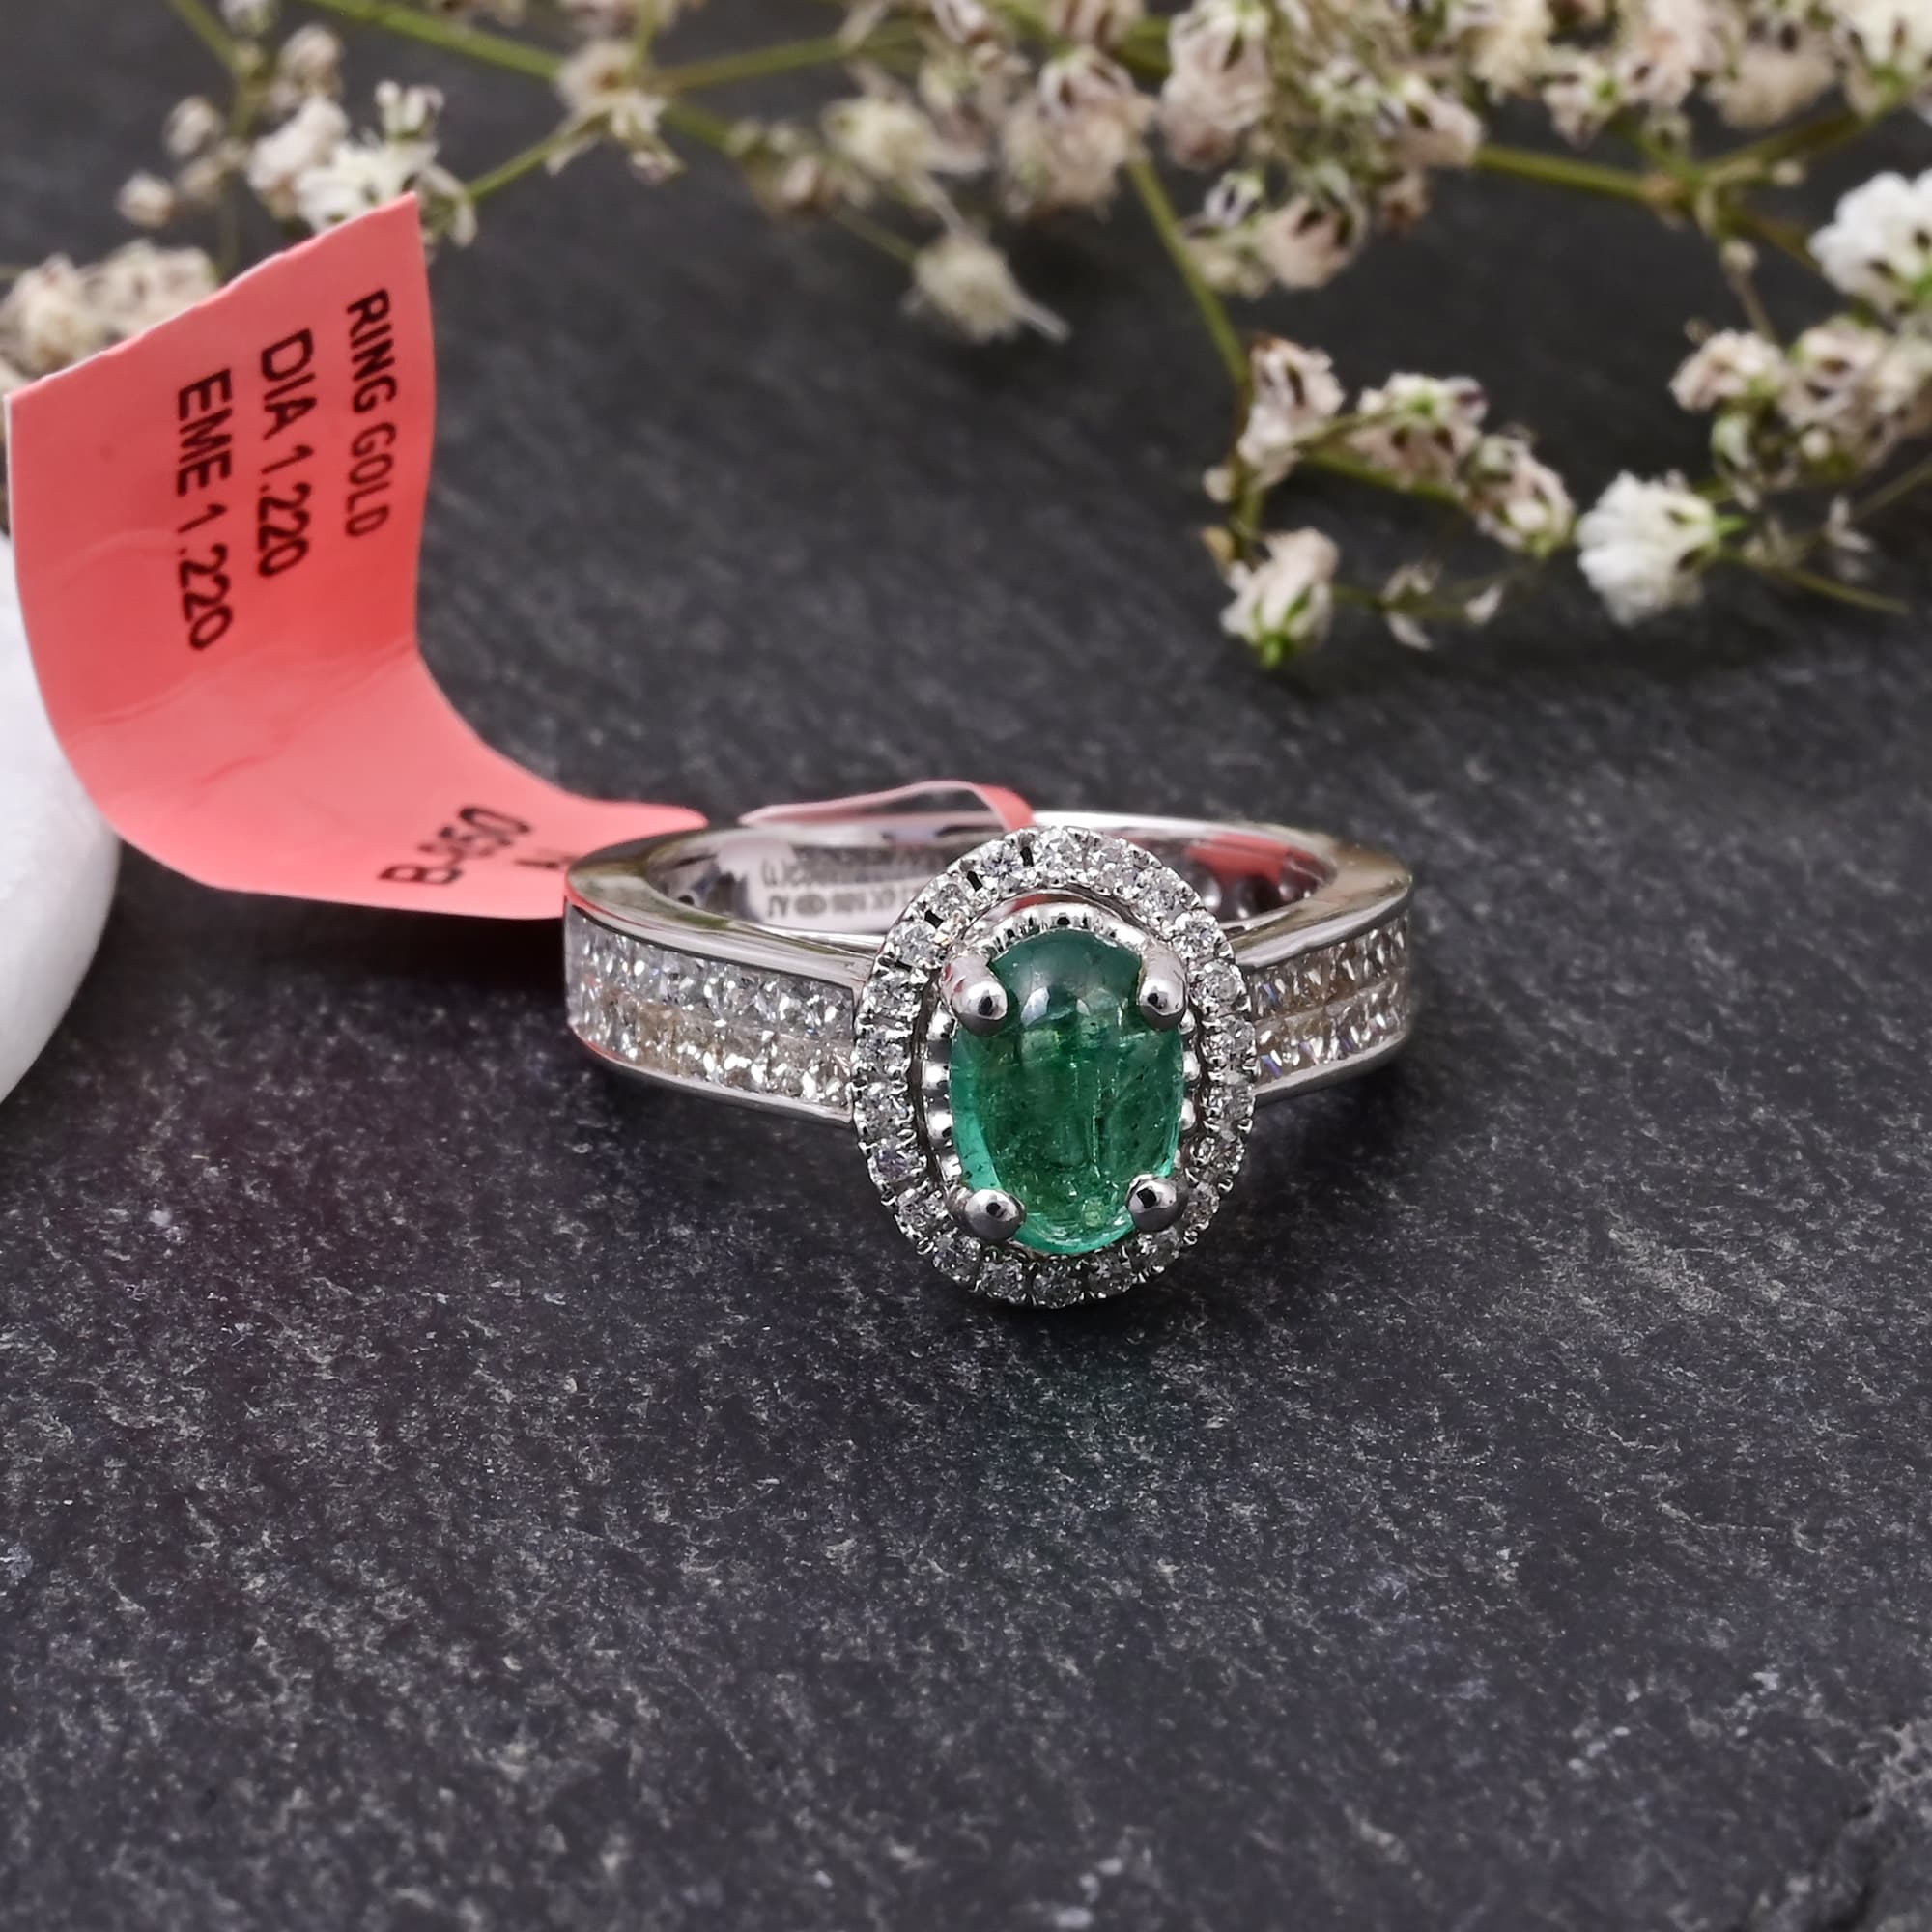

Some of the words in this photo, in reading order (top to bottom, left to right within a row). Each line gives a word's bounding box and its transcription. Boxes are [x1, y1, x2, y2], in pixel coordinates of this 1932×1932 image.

[260, 328, 317, 441] DIA
[347, 288, 397, 413] RING
[177, 368, 233, 497] EME
[345, 422, 397, 538] GOLD
[257, 445, 315, 578] 1.220
[177, 503, 233, 651] 1.220
